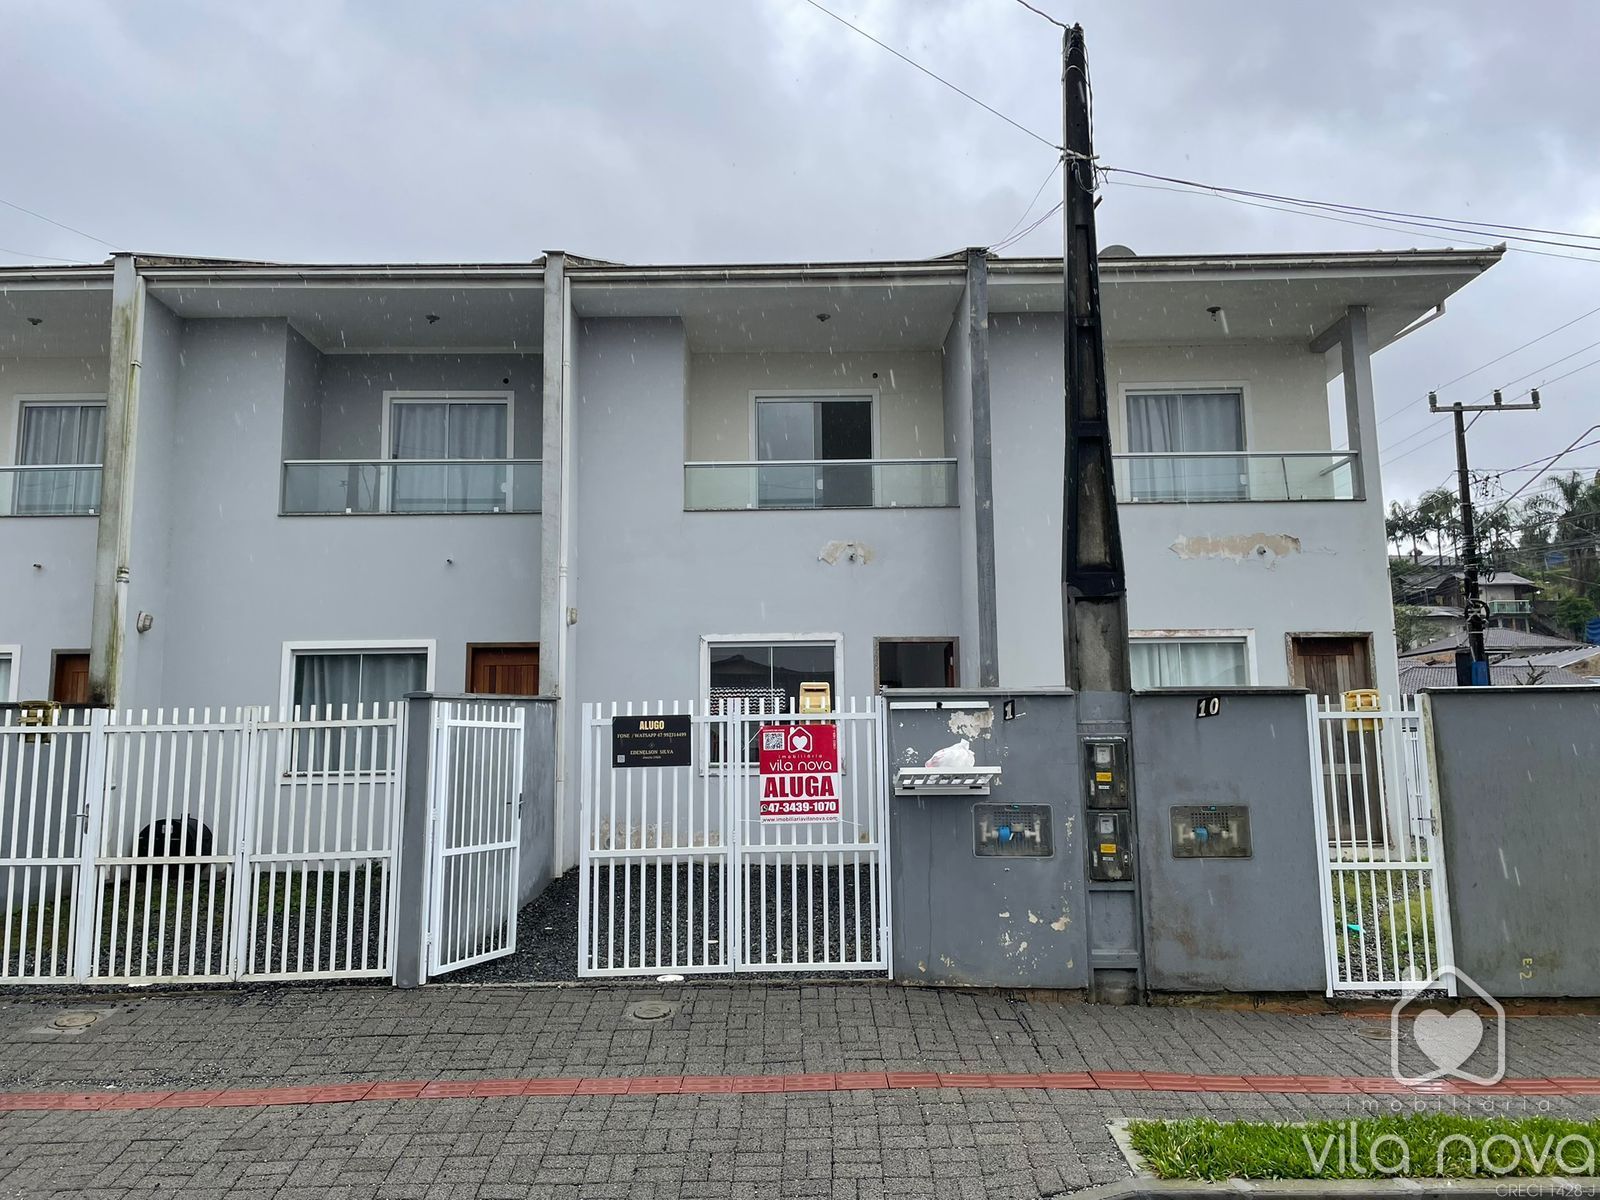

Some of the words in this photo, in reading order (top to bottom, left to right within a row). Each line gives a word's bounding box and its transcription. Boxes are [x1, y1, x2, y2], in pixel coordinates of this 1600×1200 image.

[1005, 702, 1014, 720] 1
[1198, 698, 1219, 717] 10
[639, 720, 665, 730] ALUGO
[769, 759, 793, 771] vila
[798, 760, 832, 771] nova
[764, 775, 835, 798] ALUGA
[768, 801, 836, 813] 47-3439-1070
